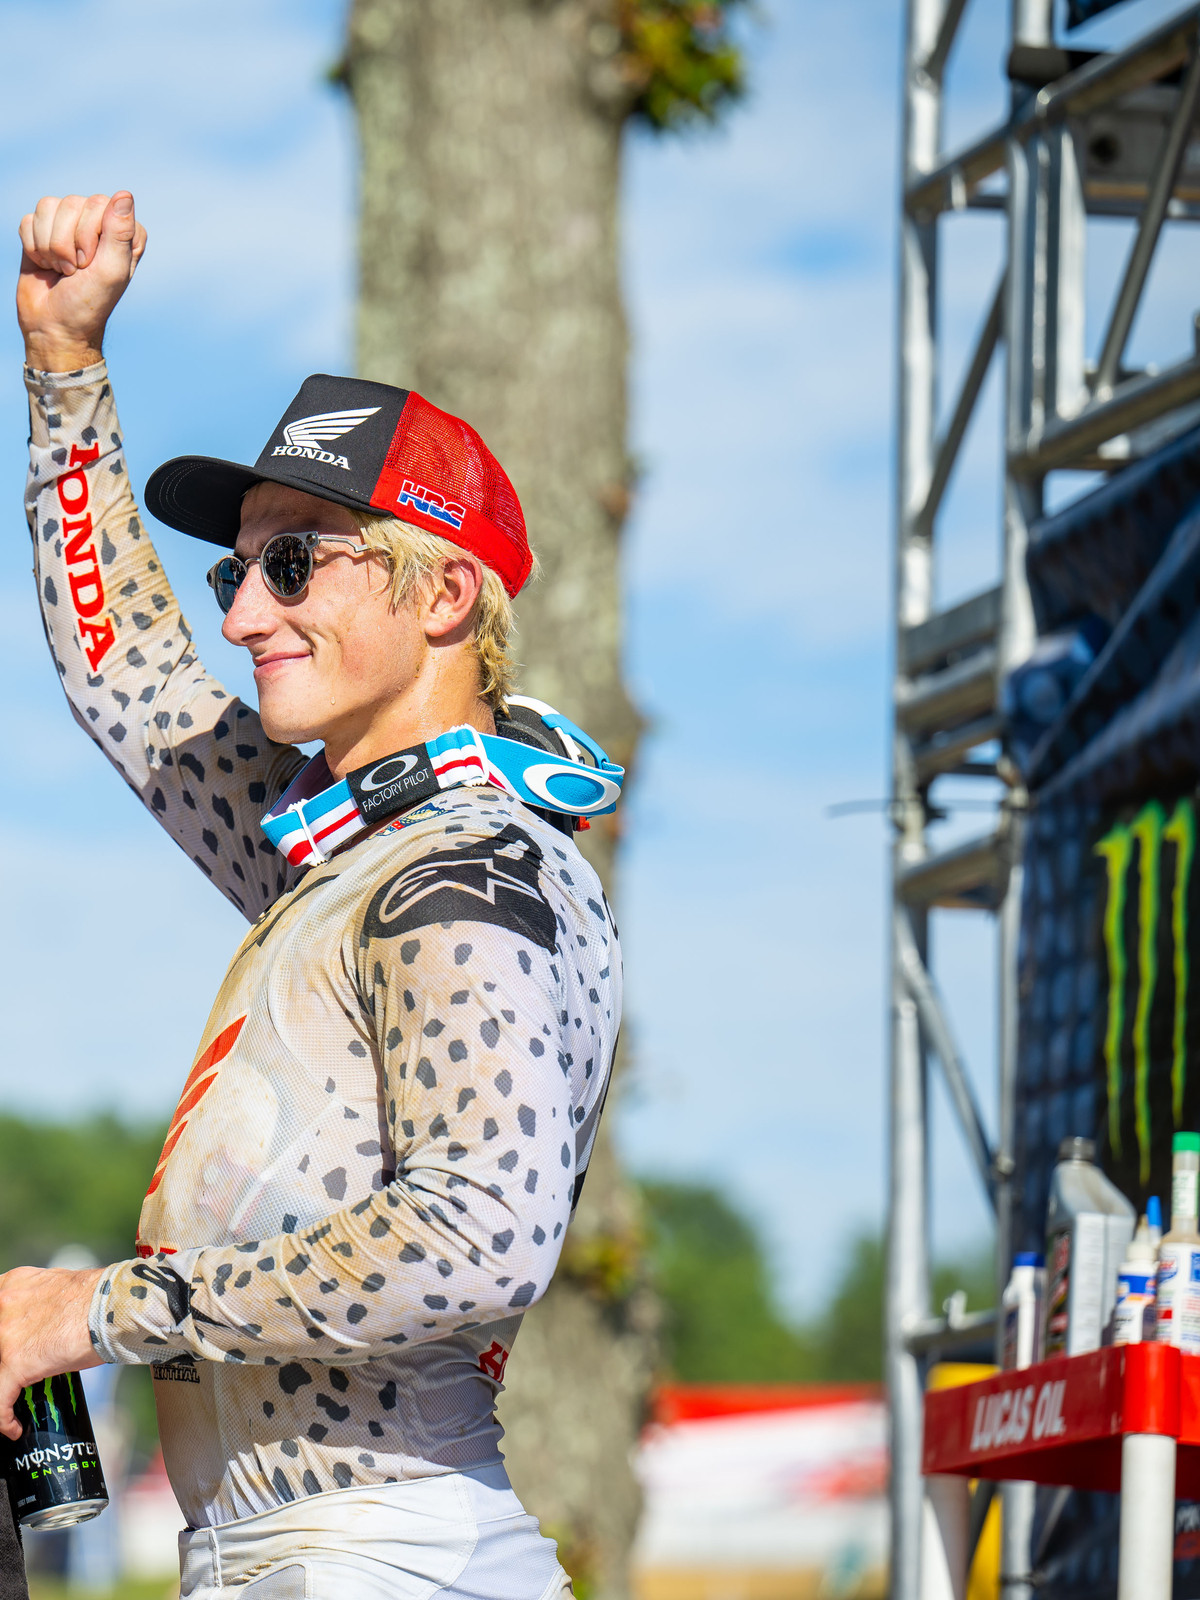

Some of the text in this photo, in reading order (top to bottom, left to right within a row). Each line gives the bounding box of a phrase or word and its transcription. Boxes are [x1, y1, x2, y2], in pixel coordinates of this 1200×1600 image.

[271, 445, 351, 471] HONDA
[397, 479, 467, 531] HRC
[362, 768, 430, 813] FACTORY PILOT
[970, 1380, 1067, 1452] LUCAS OIL
[31, 1460, 97, 1480] ENERGY
